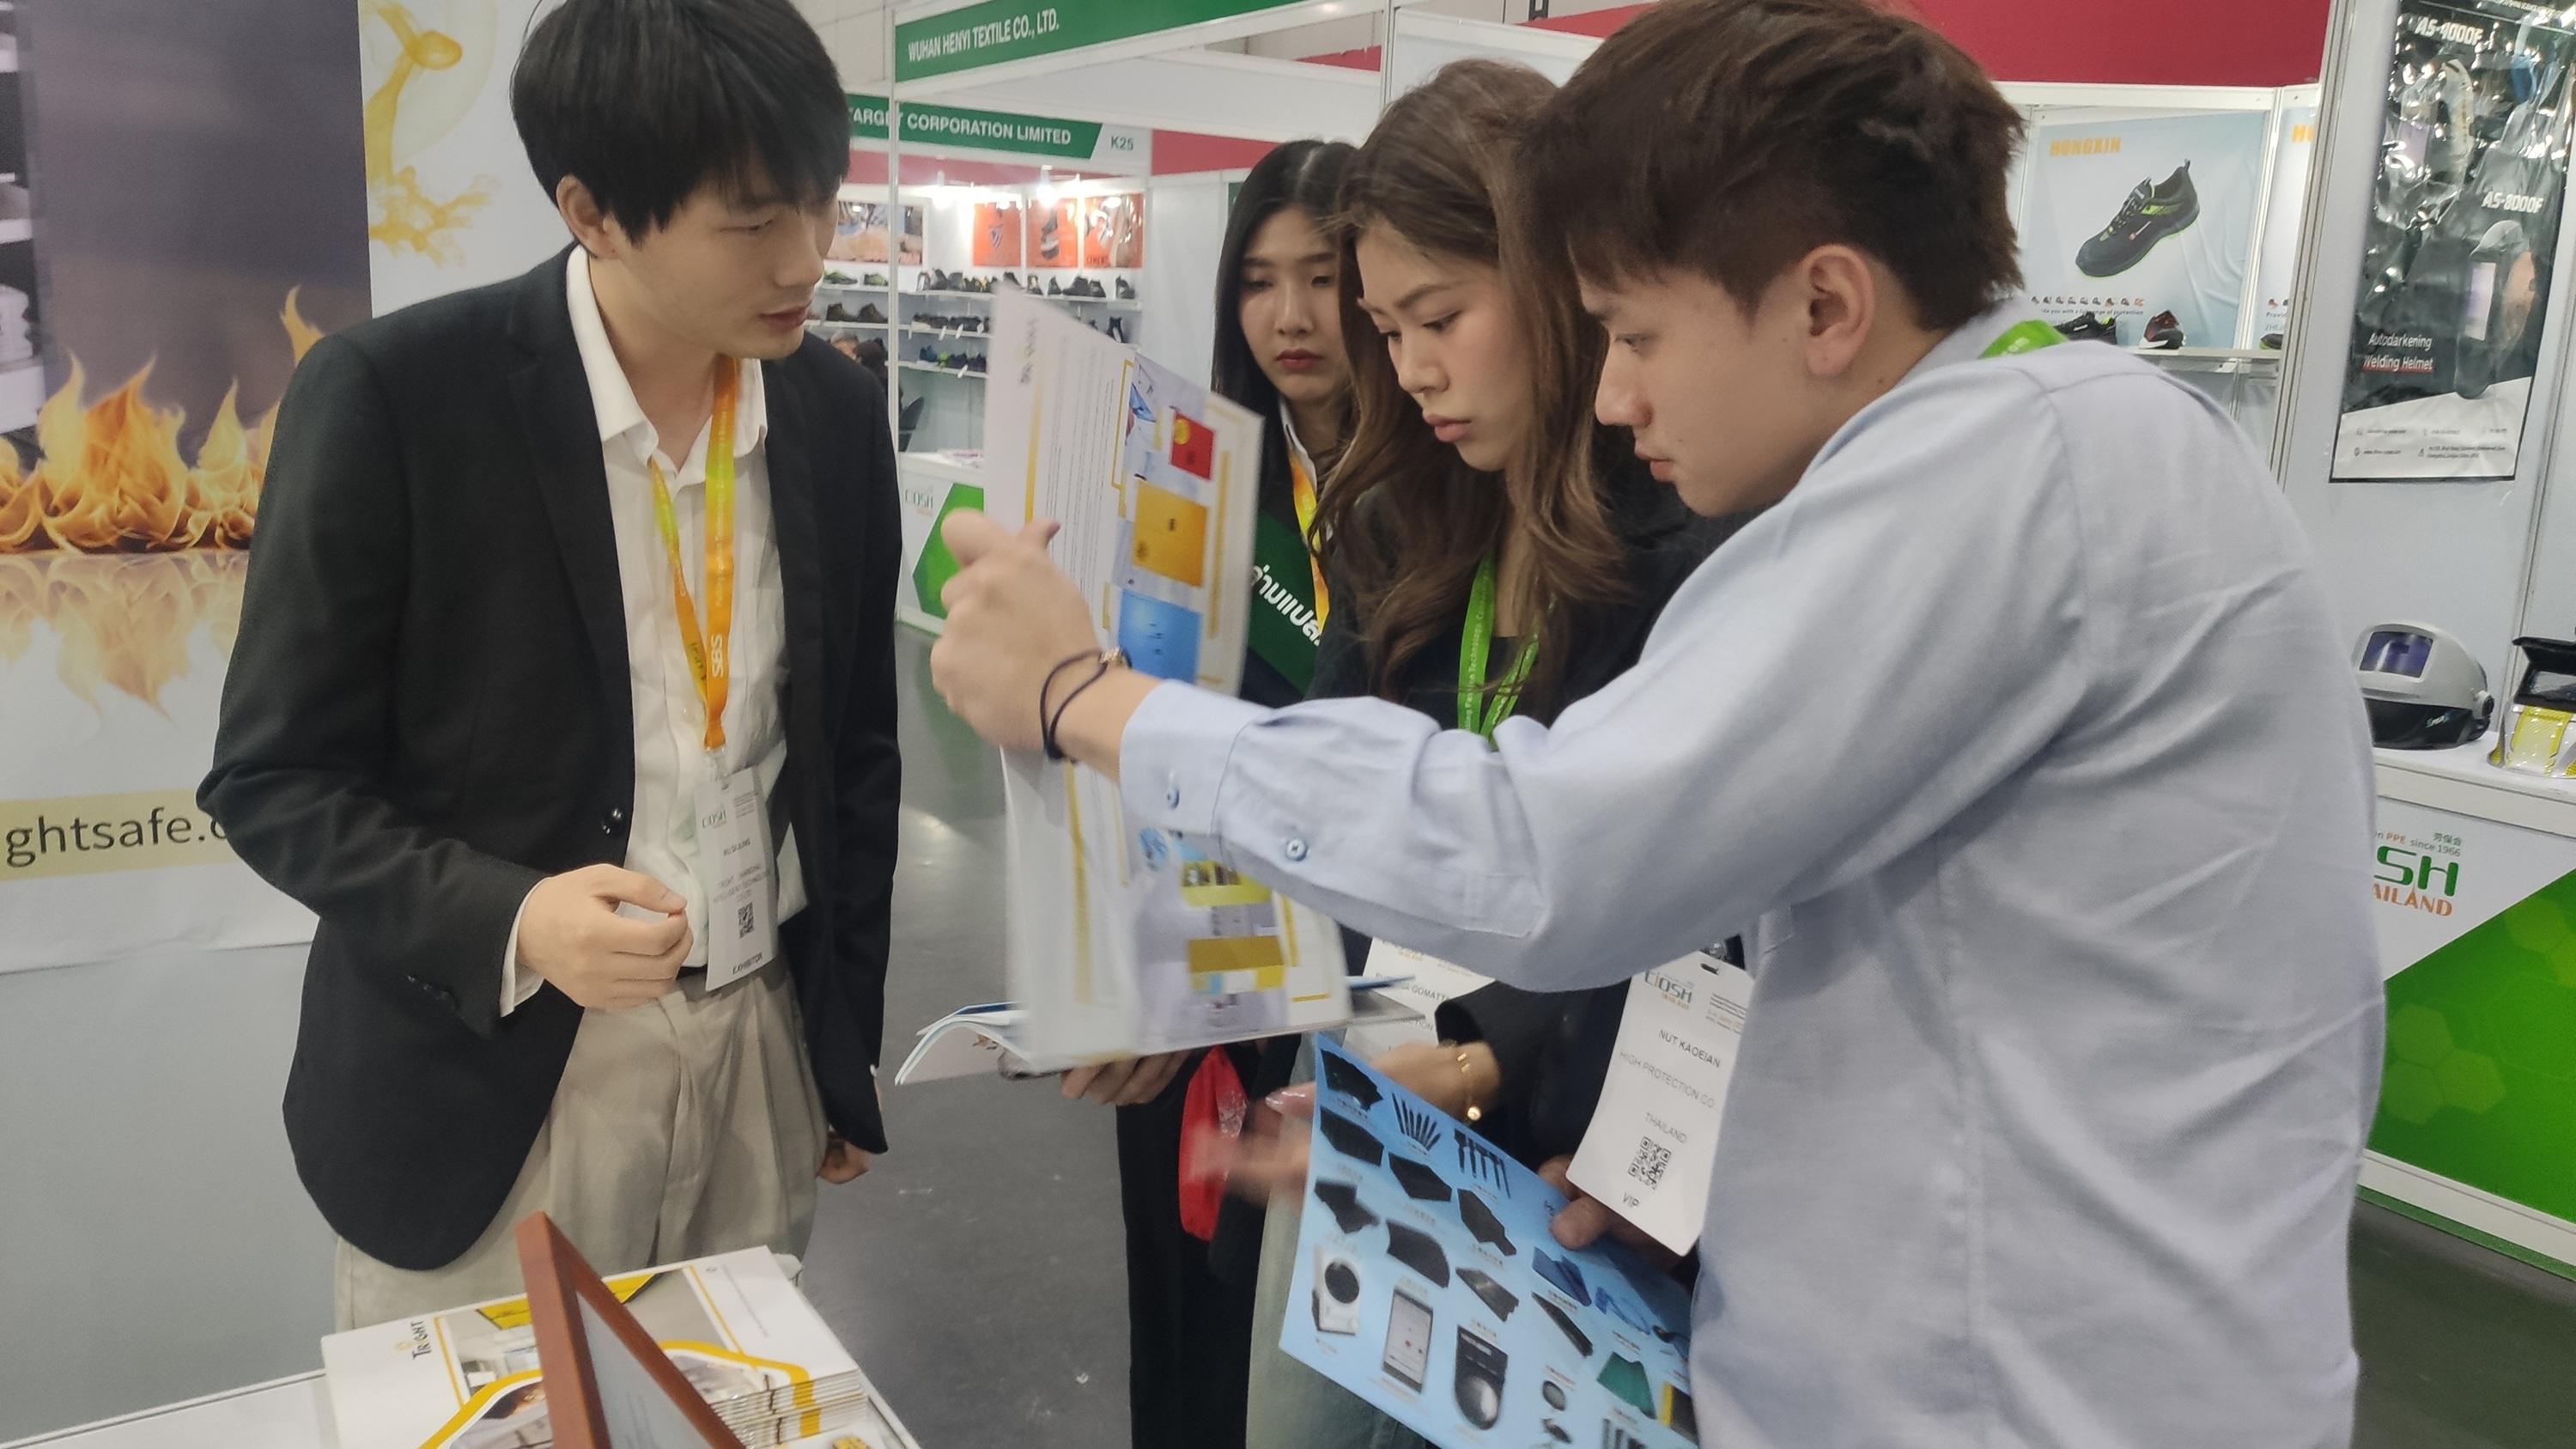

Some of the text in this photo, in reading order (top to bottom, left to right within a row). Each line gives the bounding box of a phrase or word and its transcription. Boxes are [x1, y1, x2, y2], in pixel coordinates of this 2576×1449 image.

[908, 8, 1060, 62] WUHAN HENYI TEXTILE CO., LTD.
[2414, 16, 2484, 46] AS-4000F
[907, 113, 1013, 140] CORPORATION
[1016, 124, 1072, 145] LIMITED
[2050, 137, 2122, 157] HONGXIN
[2481, 191, 2544, 214] AS-8000F
[2368, 332, 2433, 352] Autodarkening
[2363, 355, 2433, 372] Welding Helmet
[710, 633, 724, 678] SBS
[2386, 832, 2406, 844] PPE
[2410, 838, 2435, 851] since
[2437, 844, 2461, 857] 1966
[1659, 1029, 1679, 1045] NUT
[1619, 1050, 1642, 1067] HIGH
[1641, 1062, 1699, 1100] PROTECTION
[1645, 1111, 1687, 1143] THAILAND
[1622, 1191, 1640, 1208] VIP
